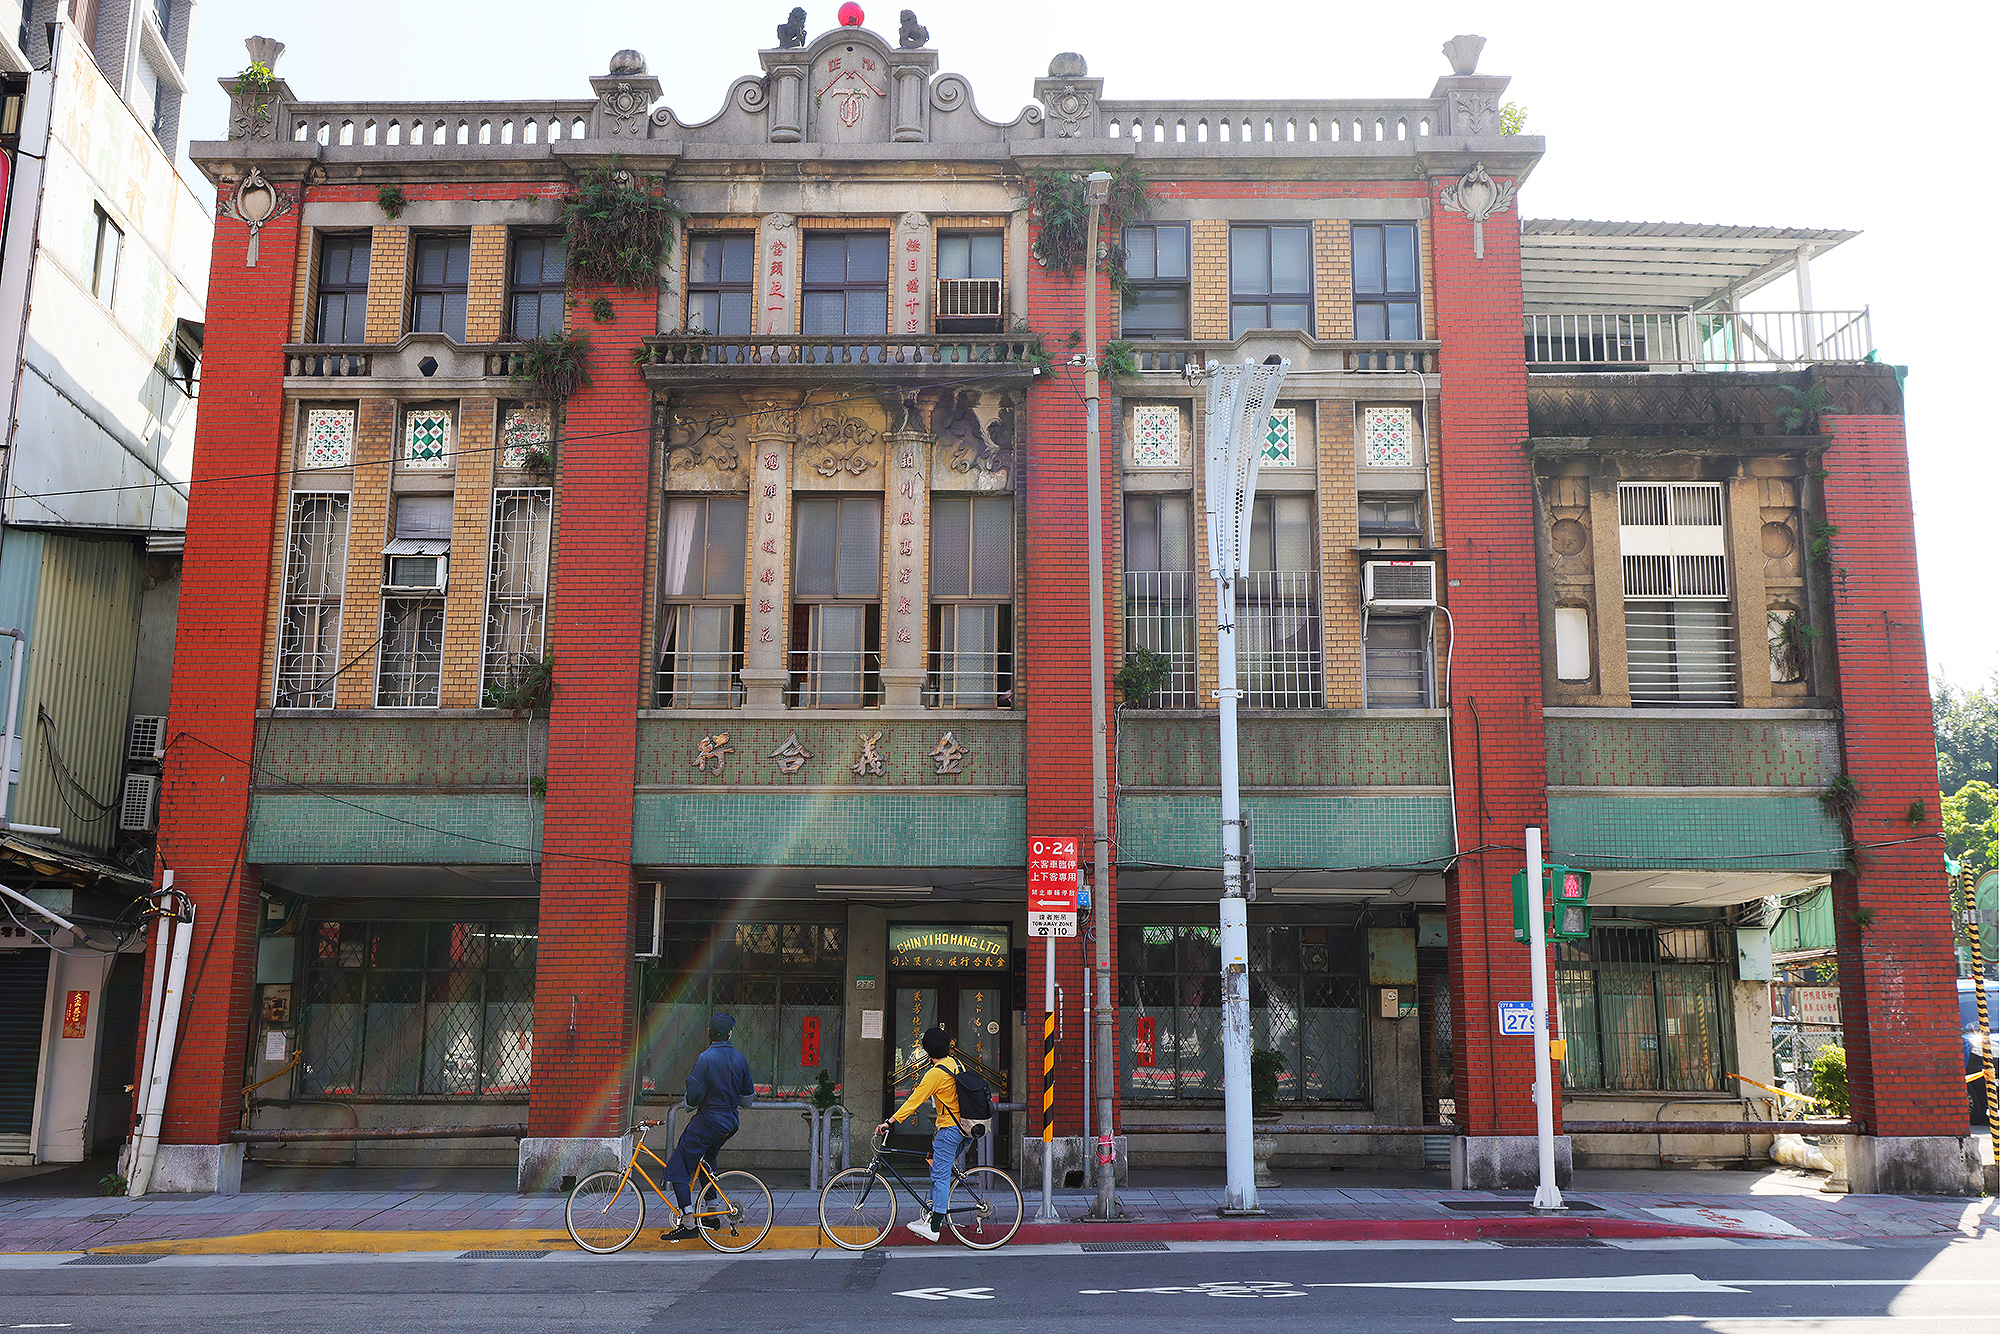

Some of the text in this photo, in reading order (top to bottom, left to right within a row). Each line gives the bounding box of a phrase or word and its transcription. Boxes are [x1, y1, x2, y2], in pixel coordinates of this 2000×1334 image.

[1033, 841, 1075, 855] 0-24
[1030, 859, 1077, 870] 大客車臨停
[1030, 872, 1077, 882] 上下客專用
[1031, 889, 1076, 897] 禁止車輛停放
[1053, 927, 1068, 936] 110
[896, 936, 922, 954] CHIN
[934, 933, 949, 945] HO
